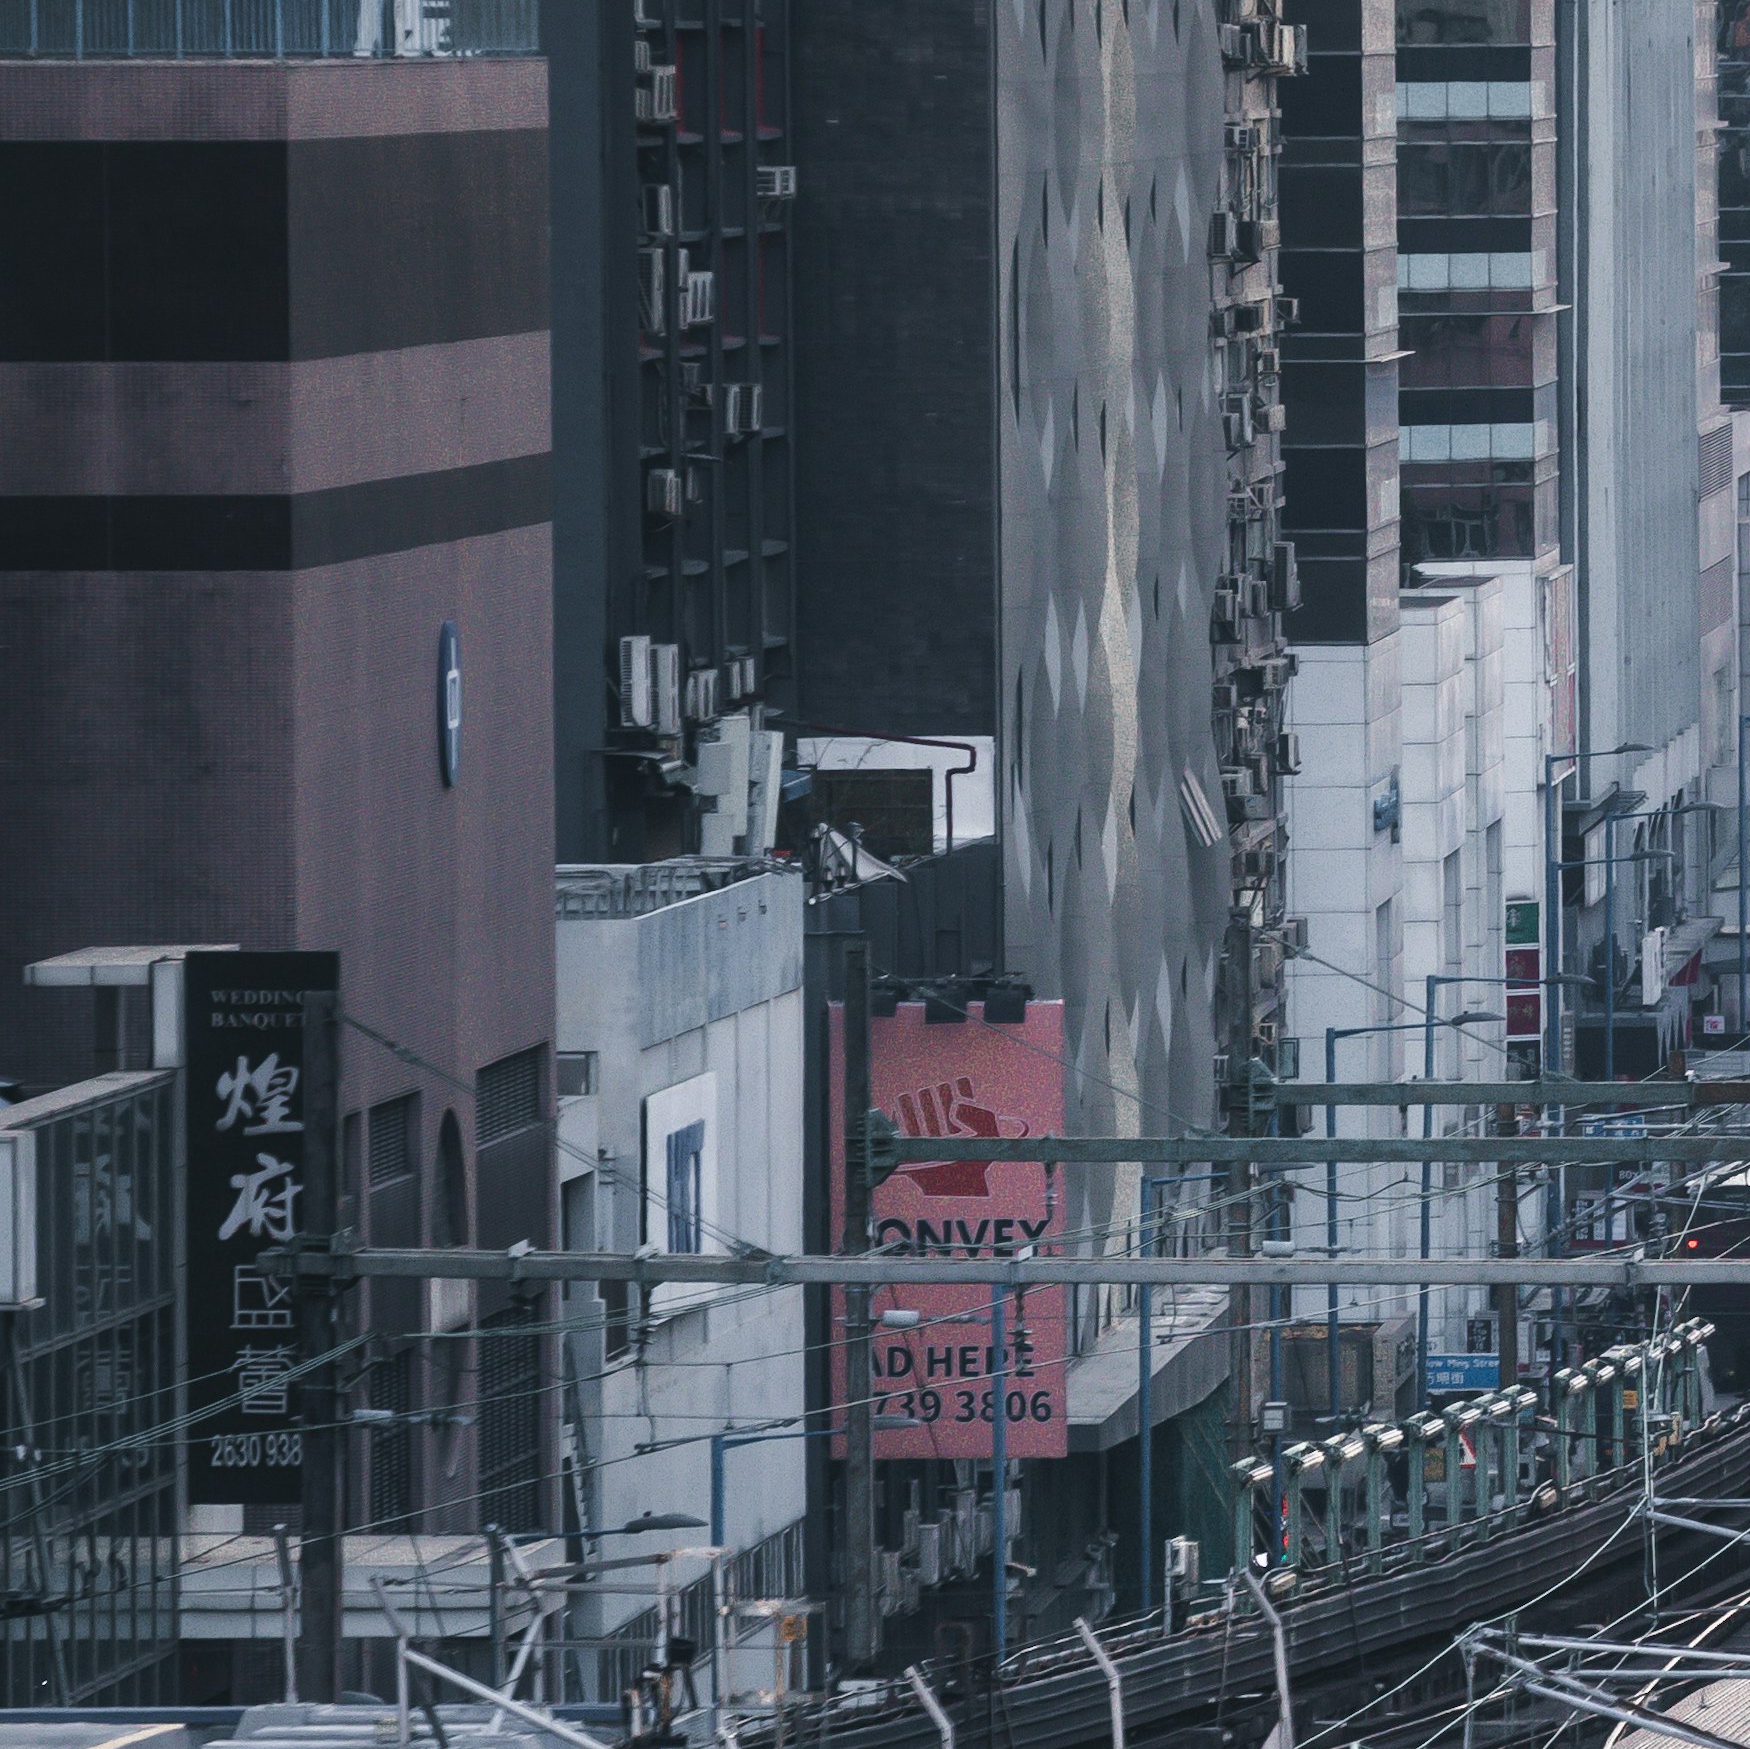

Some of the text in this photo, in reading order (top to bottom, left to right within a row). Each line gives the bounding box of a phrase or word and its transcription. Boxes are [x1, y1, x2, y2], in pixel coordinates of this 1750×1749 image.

[214, 1051, 305, 1242] 煌府
[875, 1218, 1051, 1258] ONVEY
[927, 1346, 1035, 1377] HERE
[1472, 1358, 1499, 1368] Stree
[872, 1390, 1052, 1423] 739 3806
[211, 1432, 304, 1467] 2630 938
